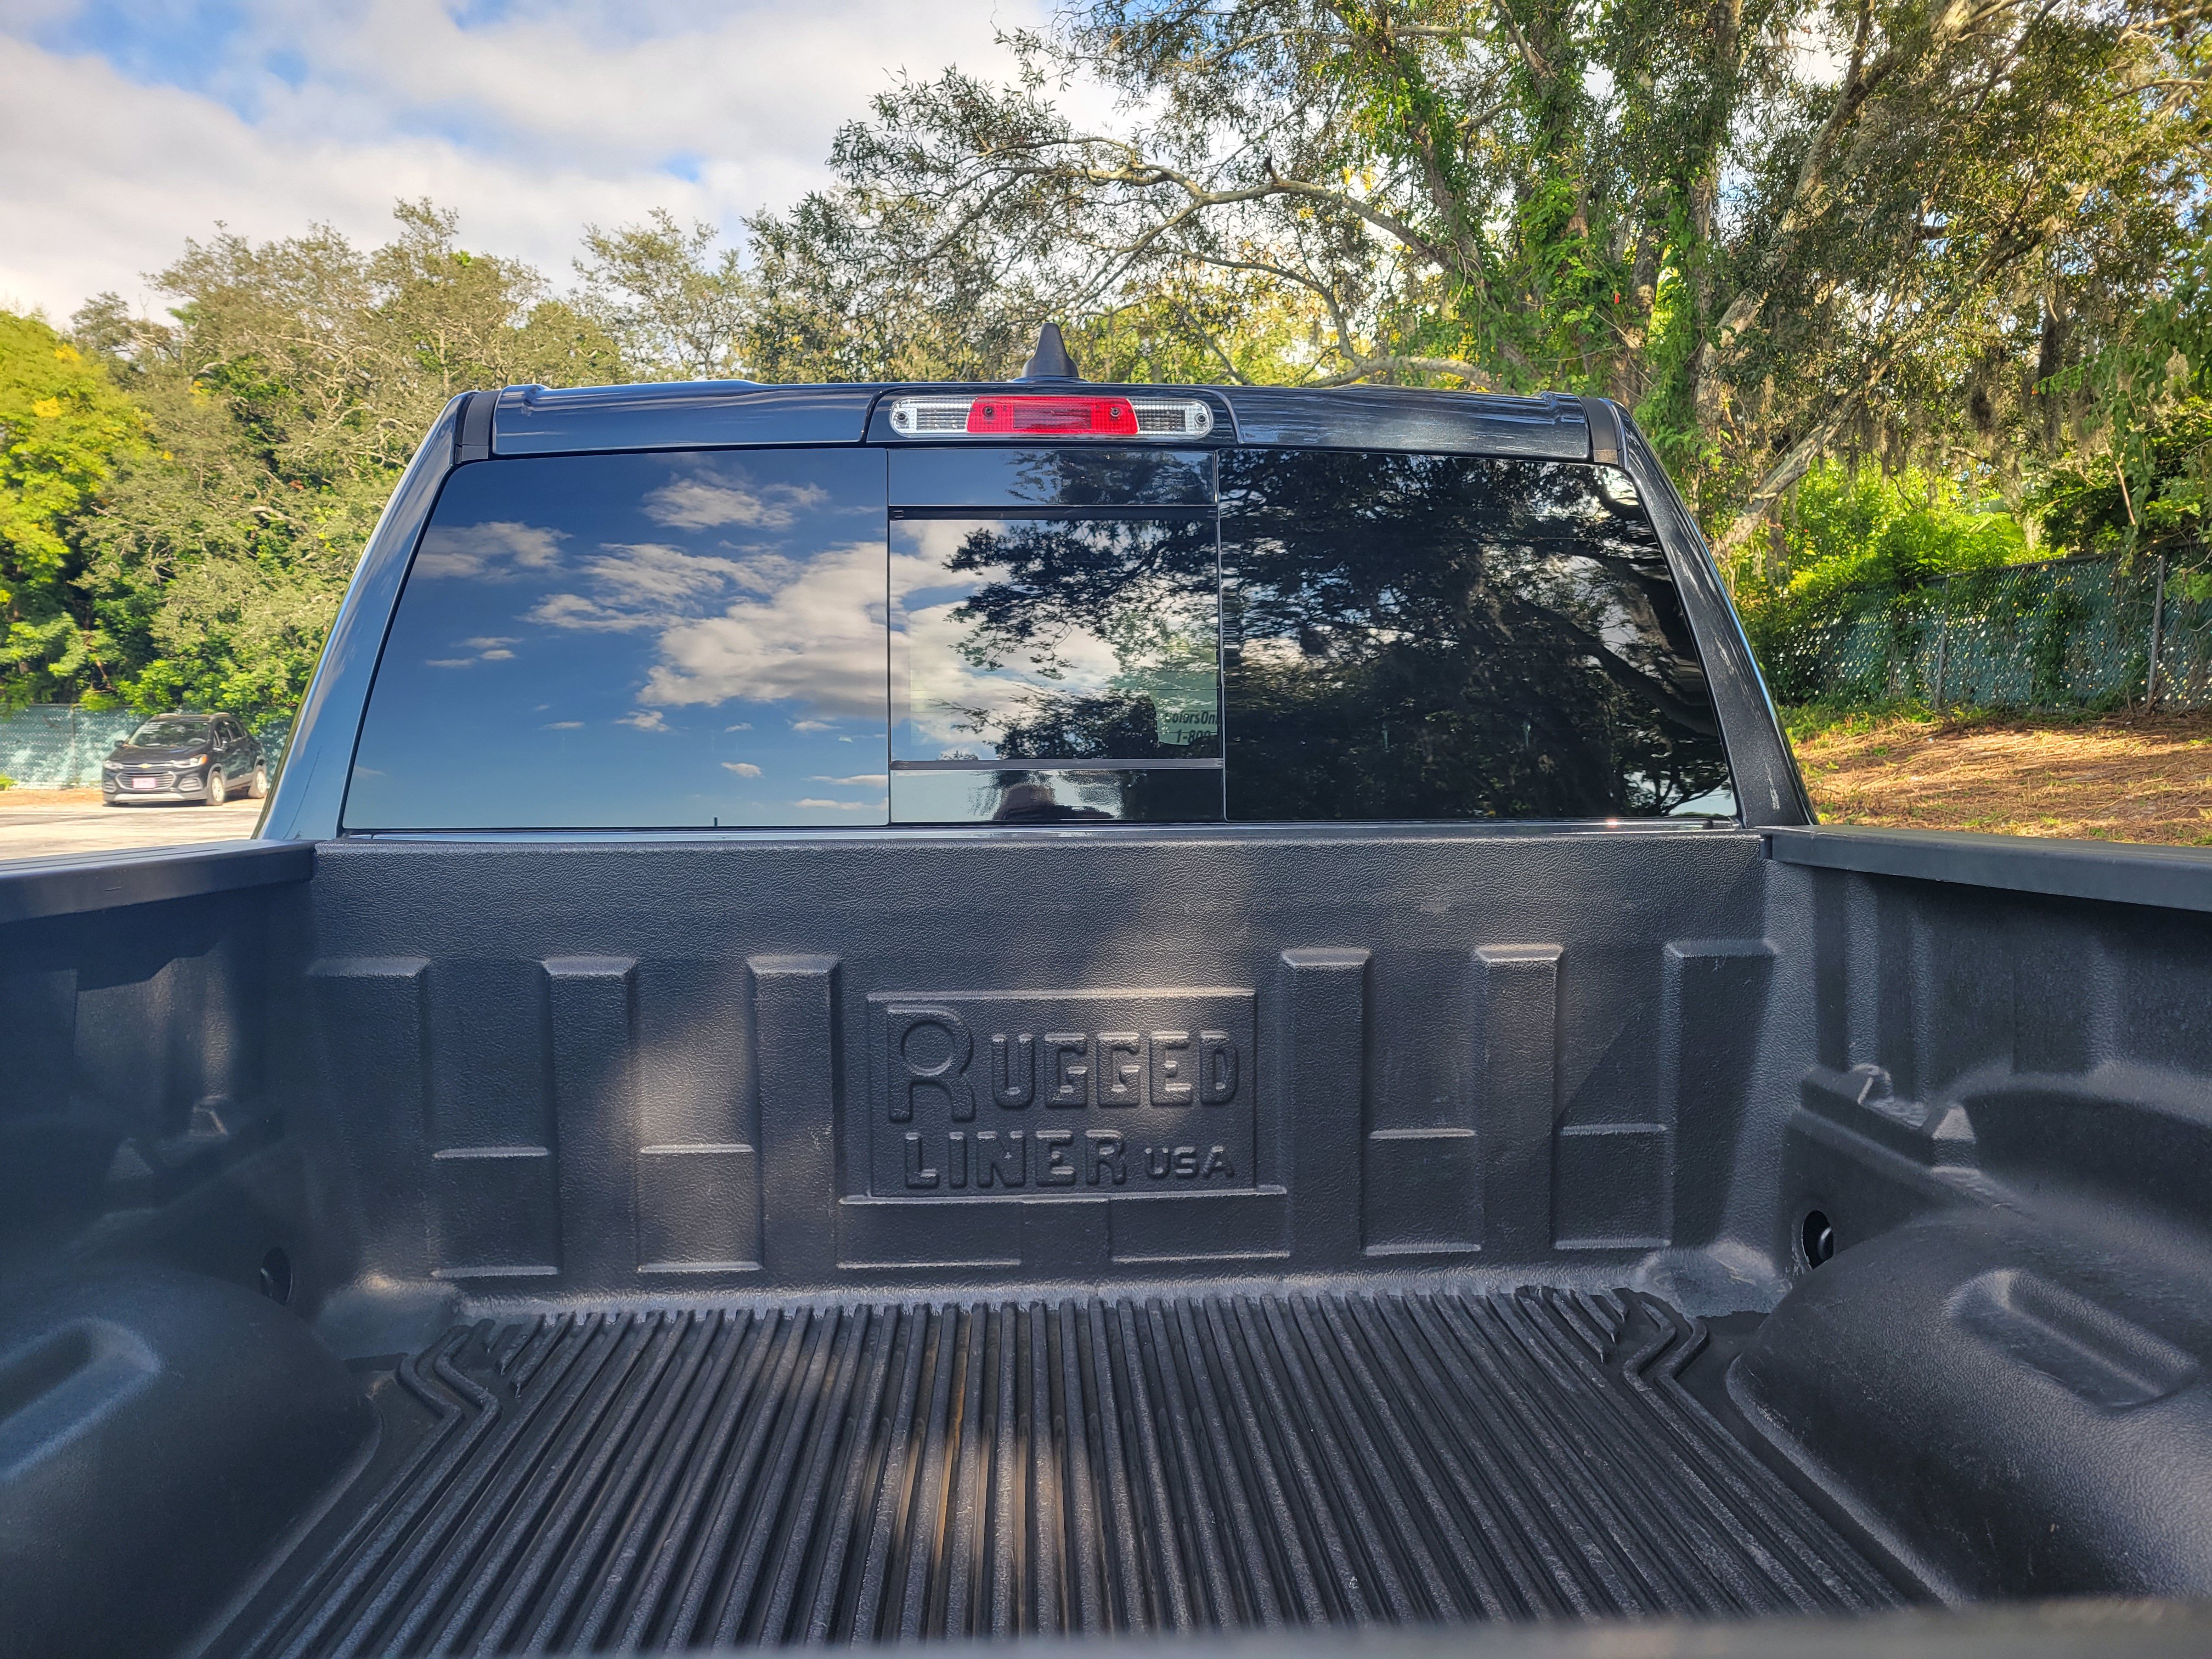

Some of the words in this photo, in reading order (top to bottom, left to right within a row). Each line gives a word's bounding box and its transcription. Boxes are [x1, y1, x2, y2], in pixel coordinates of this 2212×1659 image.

[886, 1003, 1239, 1121] RUGGED
[904, 1129, 1127, 1188] LINER
[1144, 1145, 1235, 1179] USA
